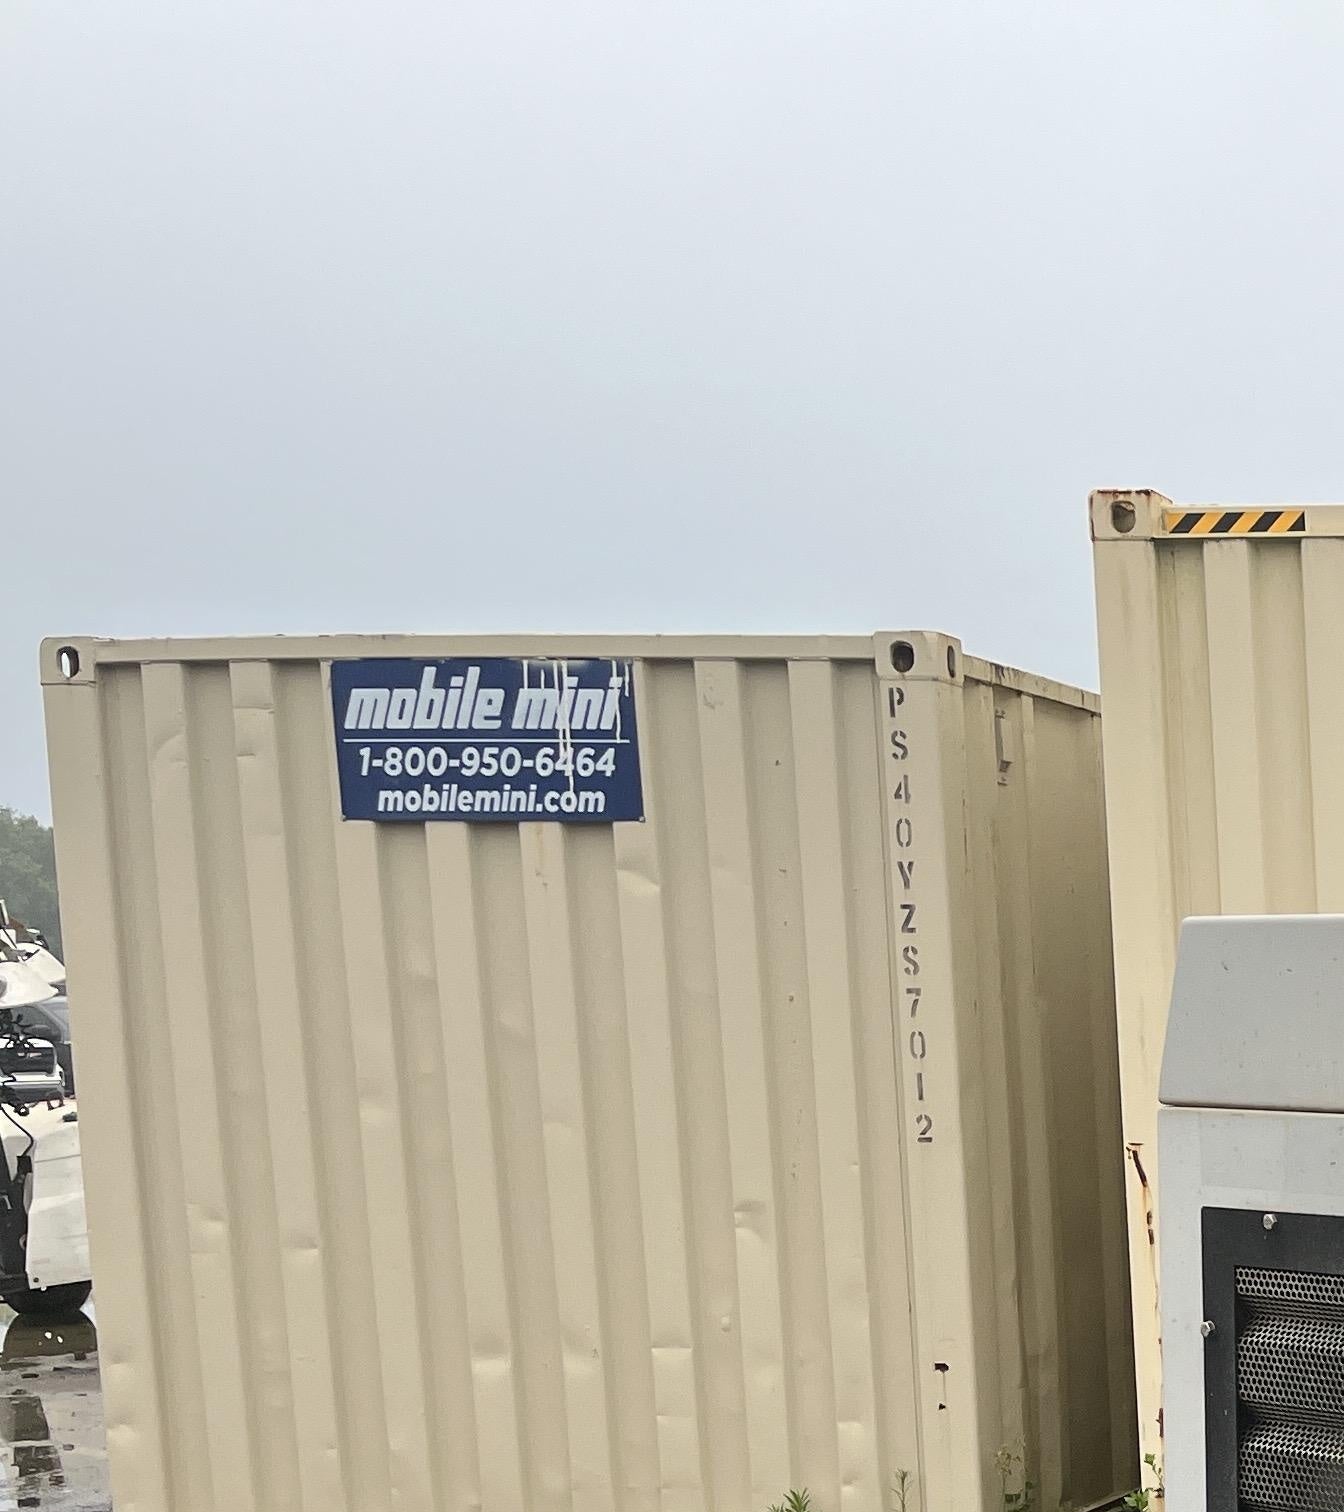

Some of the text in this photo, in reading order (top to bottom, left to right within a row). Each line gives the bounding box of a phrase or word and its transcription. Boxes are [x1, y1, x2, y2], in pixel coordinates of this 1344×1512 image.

[344, 666, 623, 730] mobile mini
[359, 746, 616, 777] 1-800-950-6464
[377, 784, 606, 813] mobilemini.com
